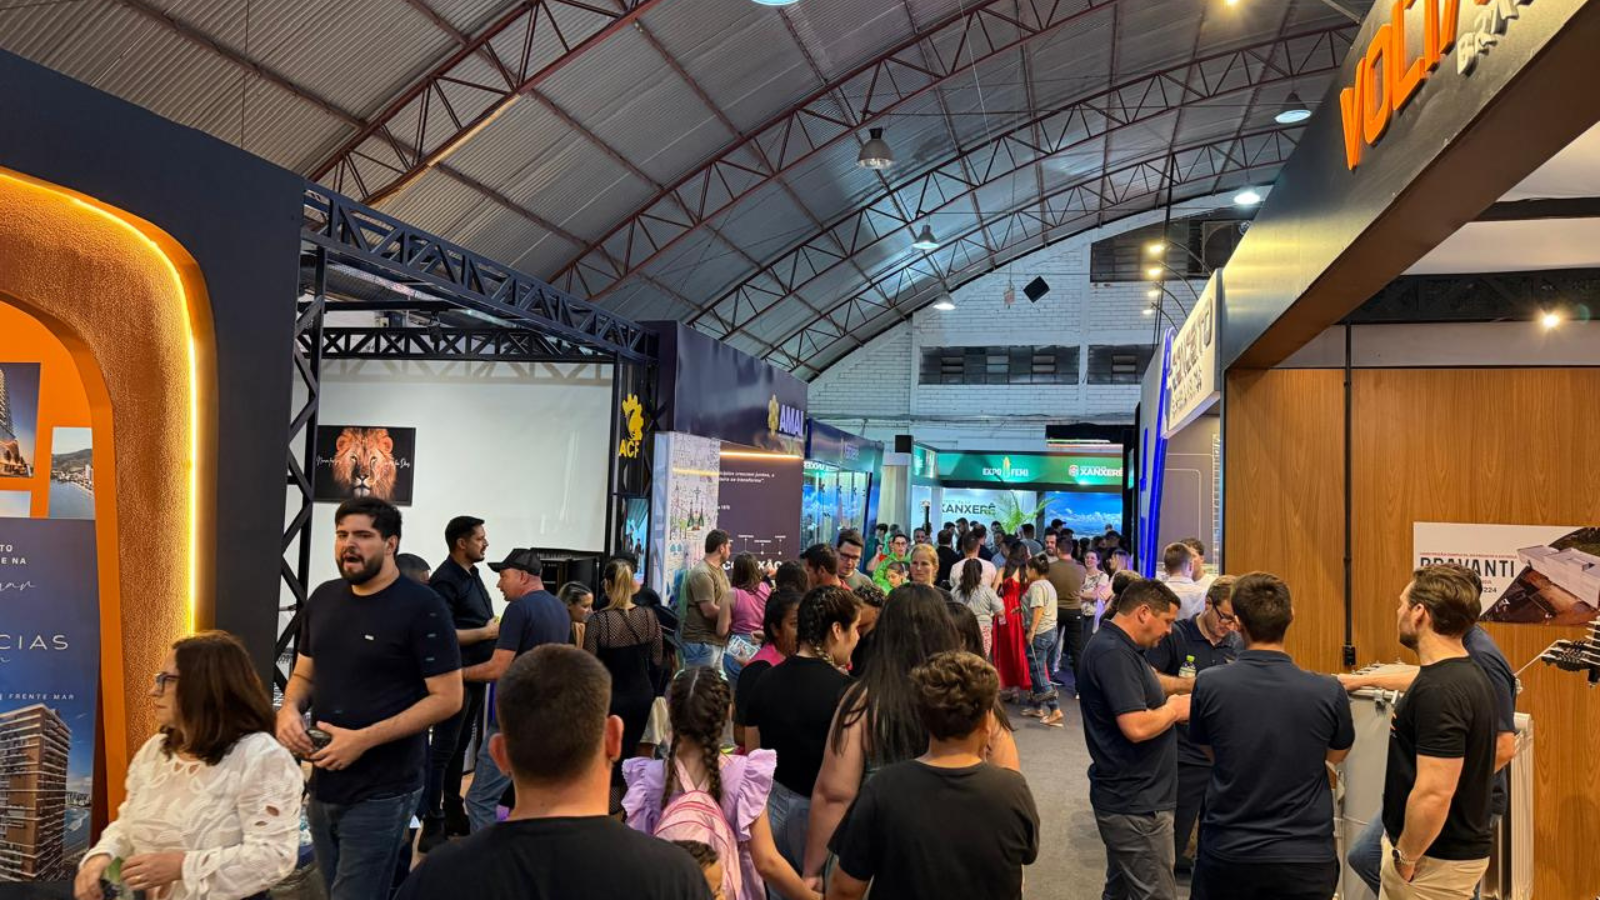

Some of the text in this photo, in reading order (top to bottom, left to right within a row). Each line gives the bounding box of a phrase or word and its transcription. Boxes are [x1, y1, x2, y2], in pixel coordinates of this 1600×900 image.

[619, 439, 640, 458] ACF
[982, 467, 1002, 476] EXPO
[12, 557, 27, 565] NA
